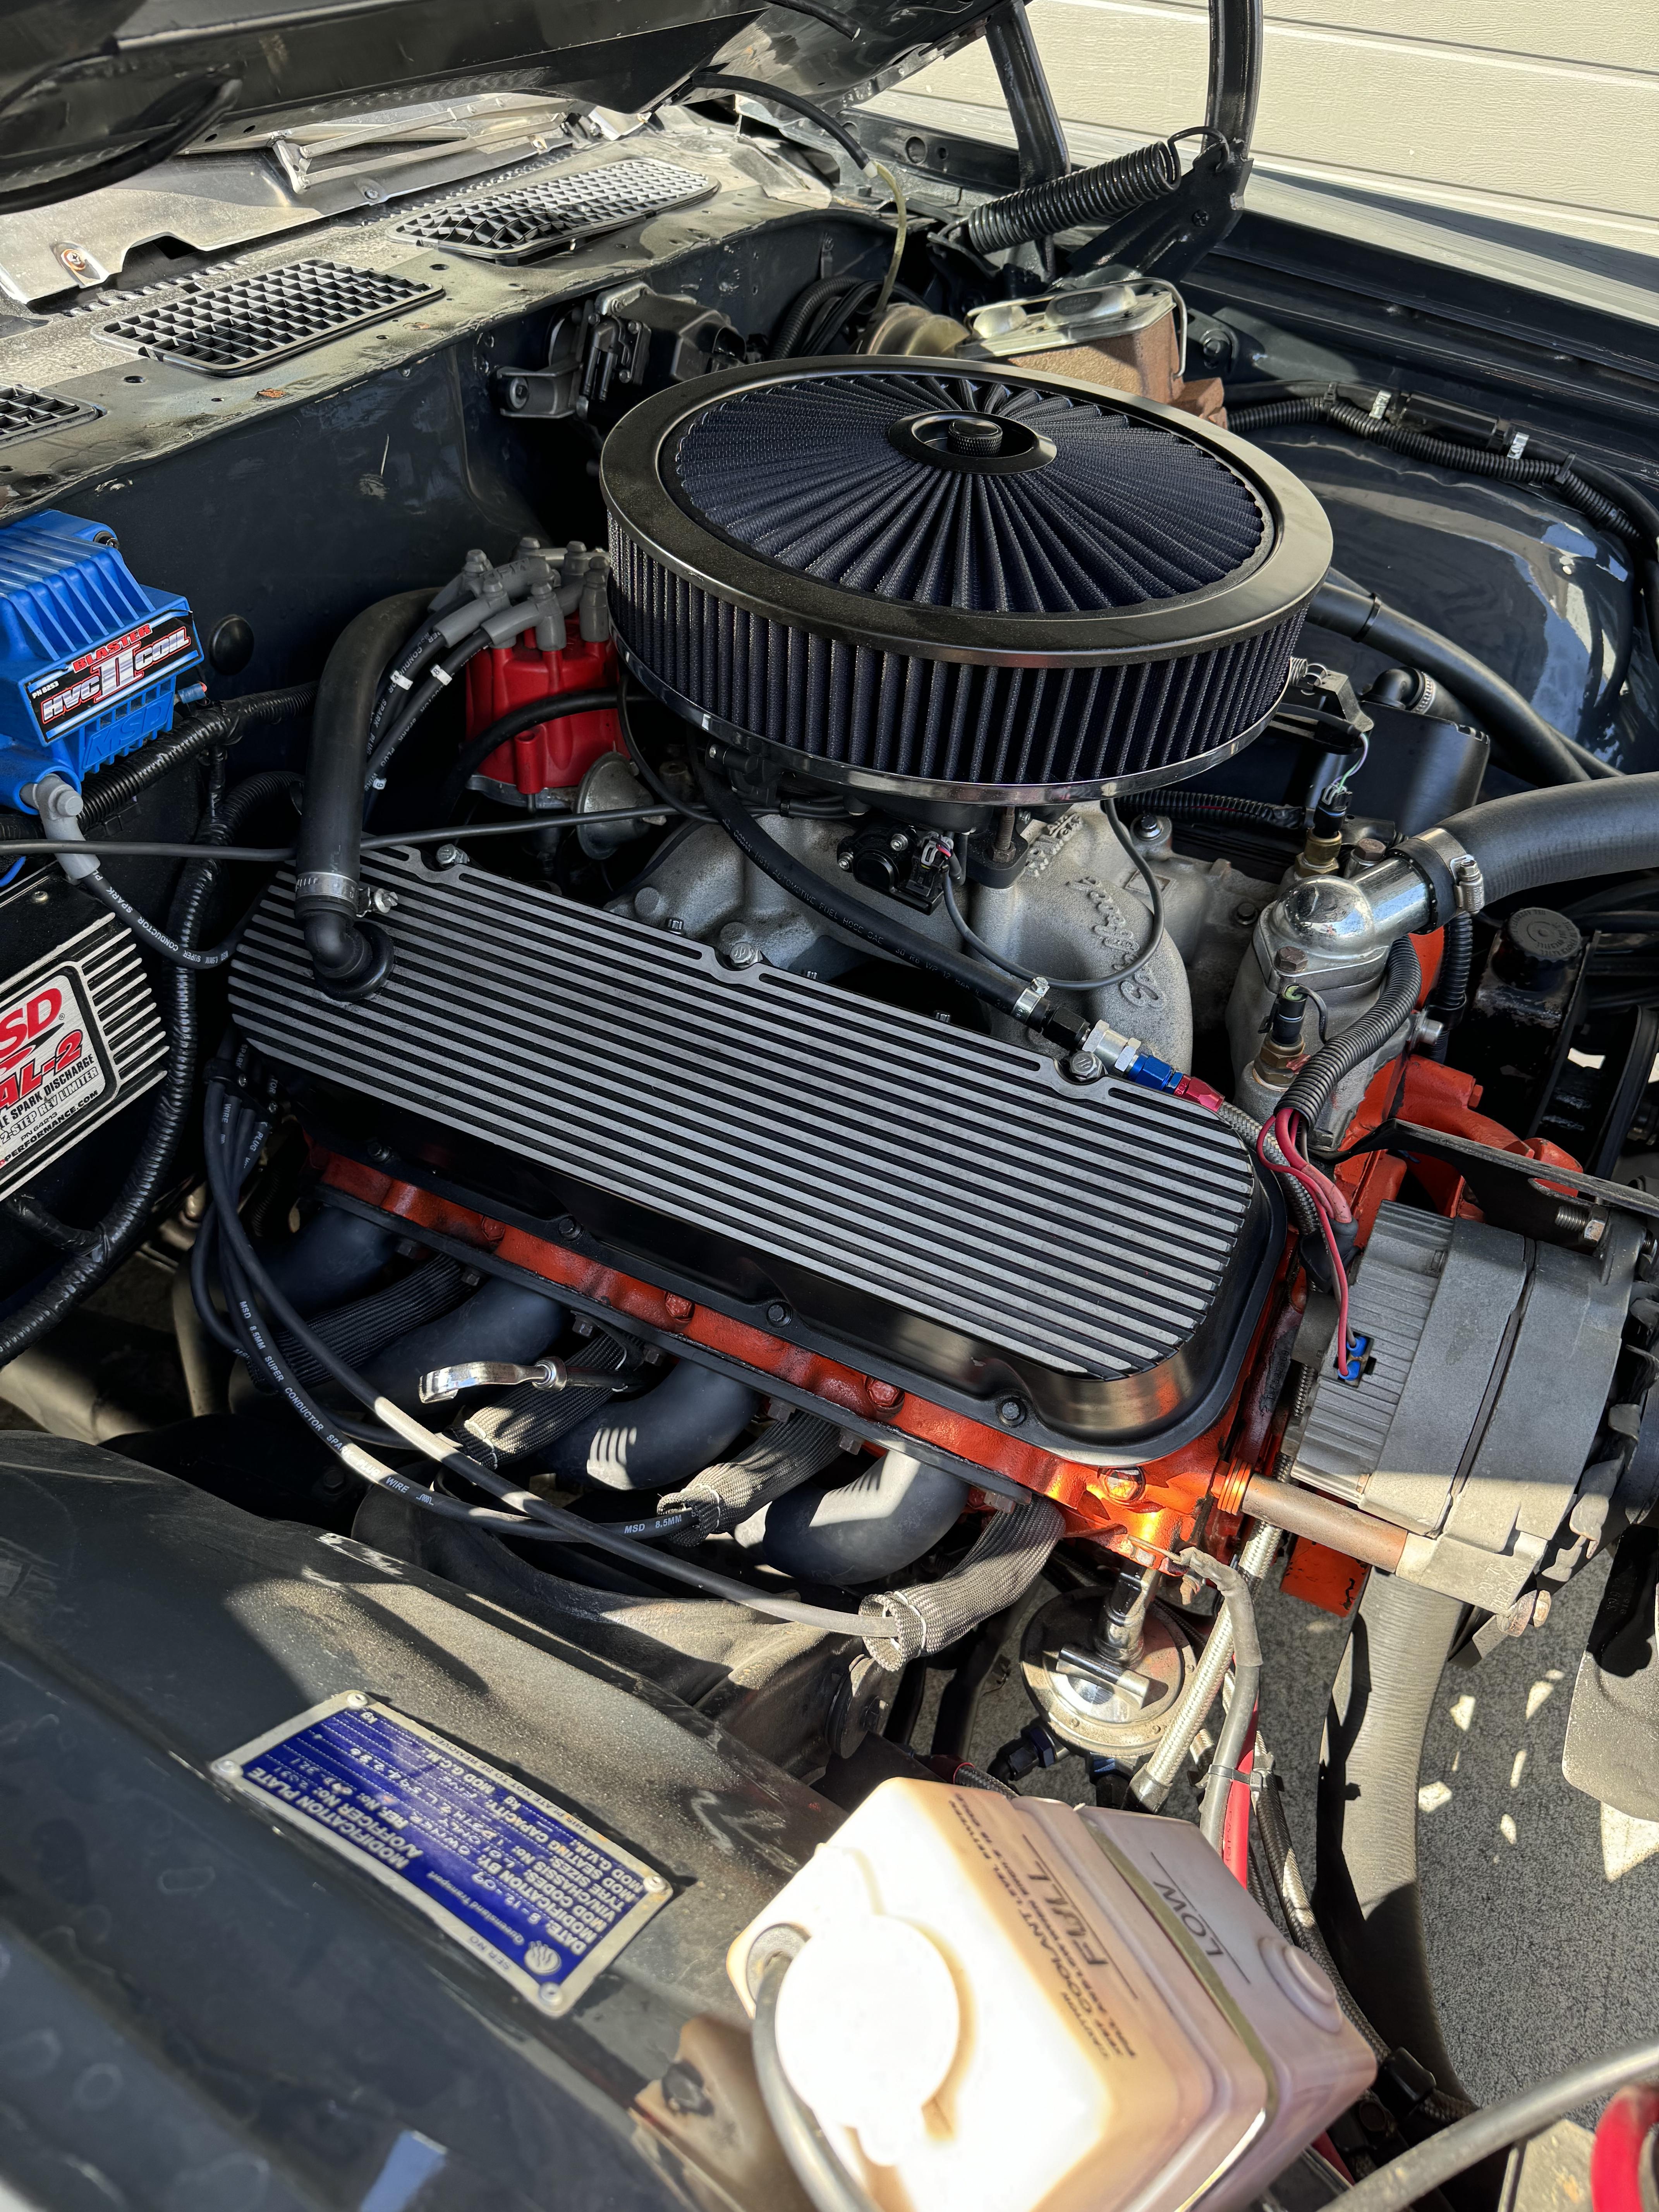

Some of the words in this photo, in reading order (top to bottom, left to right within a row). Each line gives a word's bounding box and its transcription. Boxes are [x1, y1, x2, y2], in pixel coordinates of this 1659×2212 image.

[72, 624, 152, 672] BLASTER
[42, 675, 100, 722] HVC
[135, 628, 190, 671] COIL
[375, 699, 387, 728] SPARK
[93, 708, 163, 756] MSD
[380, 747, 395, 767] PLUG
[106, 886, 133, 913] SPARK
[137, 916, 179, 951] CONDUCTOR
[819, 902, 838, 919] FUEL
[842, 917, 864, 933] HOSE
[942, 970, 951, 979] 12
[182, 950, 201, 962] SUPER
[235, 1044, 248, 1070] SPARK
[10, 1091, 43, 1120] SPARK
[43, 1054, 94, 1096] DISCHARGE
[38, 1094, 58, 1116] REV
[58, 1066, 99, 1102] LIMITER
[222, 1103, 232, 1123] WIRE
[21, 1130, 33, 1141] PN
[250, 1130, 264, 1152] PLUG
[239, 1301, 251, 1319] MSD
[250, 1326, 266, 1350] 8.5MM
[264, 1355, 284, 1382] SUPER
[285, 1387, 324, 1432] CONDUCTOR
[326, 1434, 356, 1458] SPARK
[385, 1477, 410, 1494] WIRE
[624, 1523, 645, 1534] MSD
[655, 1515, 682, 1528] 8.5MM
[358, 1711, 379, 1724] kg
[429, 1735, 479, 1764] REMOVED
[245, 1766, 302, 1801] PLATE
[461, 1772, 498, 1795] MOD
[479, 1764, 493, 1773] BE
[494, 1772, 510, 1783] TO
[309, 1786, 343, 1808] No:
[353, 1792, 381, 1811] No:
[438, 1774, 479, 1800] FIVE
[510, 1782, 532, 1796] NOT
[501, 1795, 523, 1811] kg
[532, 1795, 565, 1817] PLATE
[294, 1795, 411, 1870] MODIFICATION
[334, 1802, 424, 1861] A/OFFICER
[406, 1812, 473, 1856] OWNER
[437, 1816, 483, 1846] ONLY
[481, 1798, 551, 1844] CAPACITY:
[565, 1817, 590, 1833] THIS
[474, 1854, 503, 1875] BY:
[509, 1845, 537, 1865] No:
[545, 1839, 605, 1882] SEATING
[546, 1855, 592, 1888] SIZES:
[609, 1867, 646, 1894] MOD
[990, 1864, 1024, 1904] LEVEL
[425, 1869, 473, 1905] Transport
[520, 1868, 576, 1909] CODES:
[531, 1860, 618, 1922] VIN/CHASSIS
[587, 1882, 628, 1913] TYRE
[599, 1876, 637, 1903] MOD
[497, 1869, 599, 1944] MODIFICATION
[570, 1903, 608, 1933] MOD
[1028, 1860, 1109, 1965] FULL
[1153, 1881, 1224, 1956] LOW
[468, 1901, 527, 1946] Queensland
[541, 1919, 588, 1956] DATE:
[488, 1950, 511, 1970] SER
[1018, 1909, 1095, 2013] COOLANT
